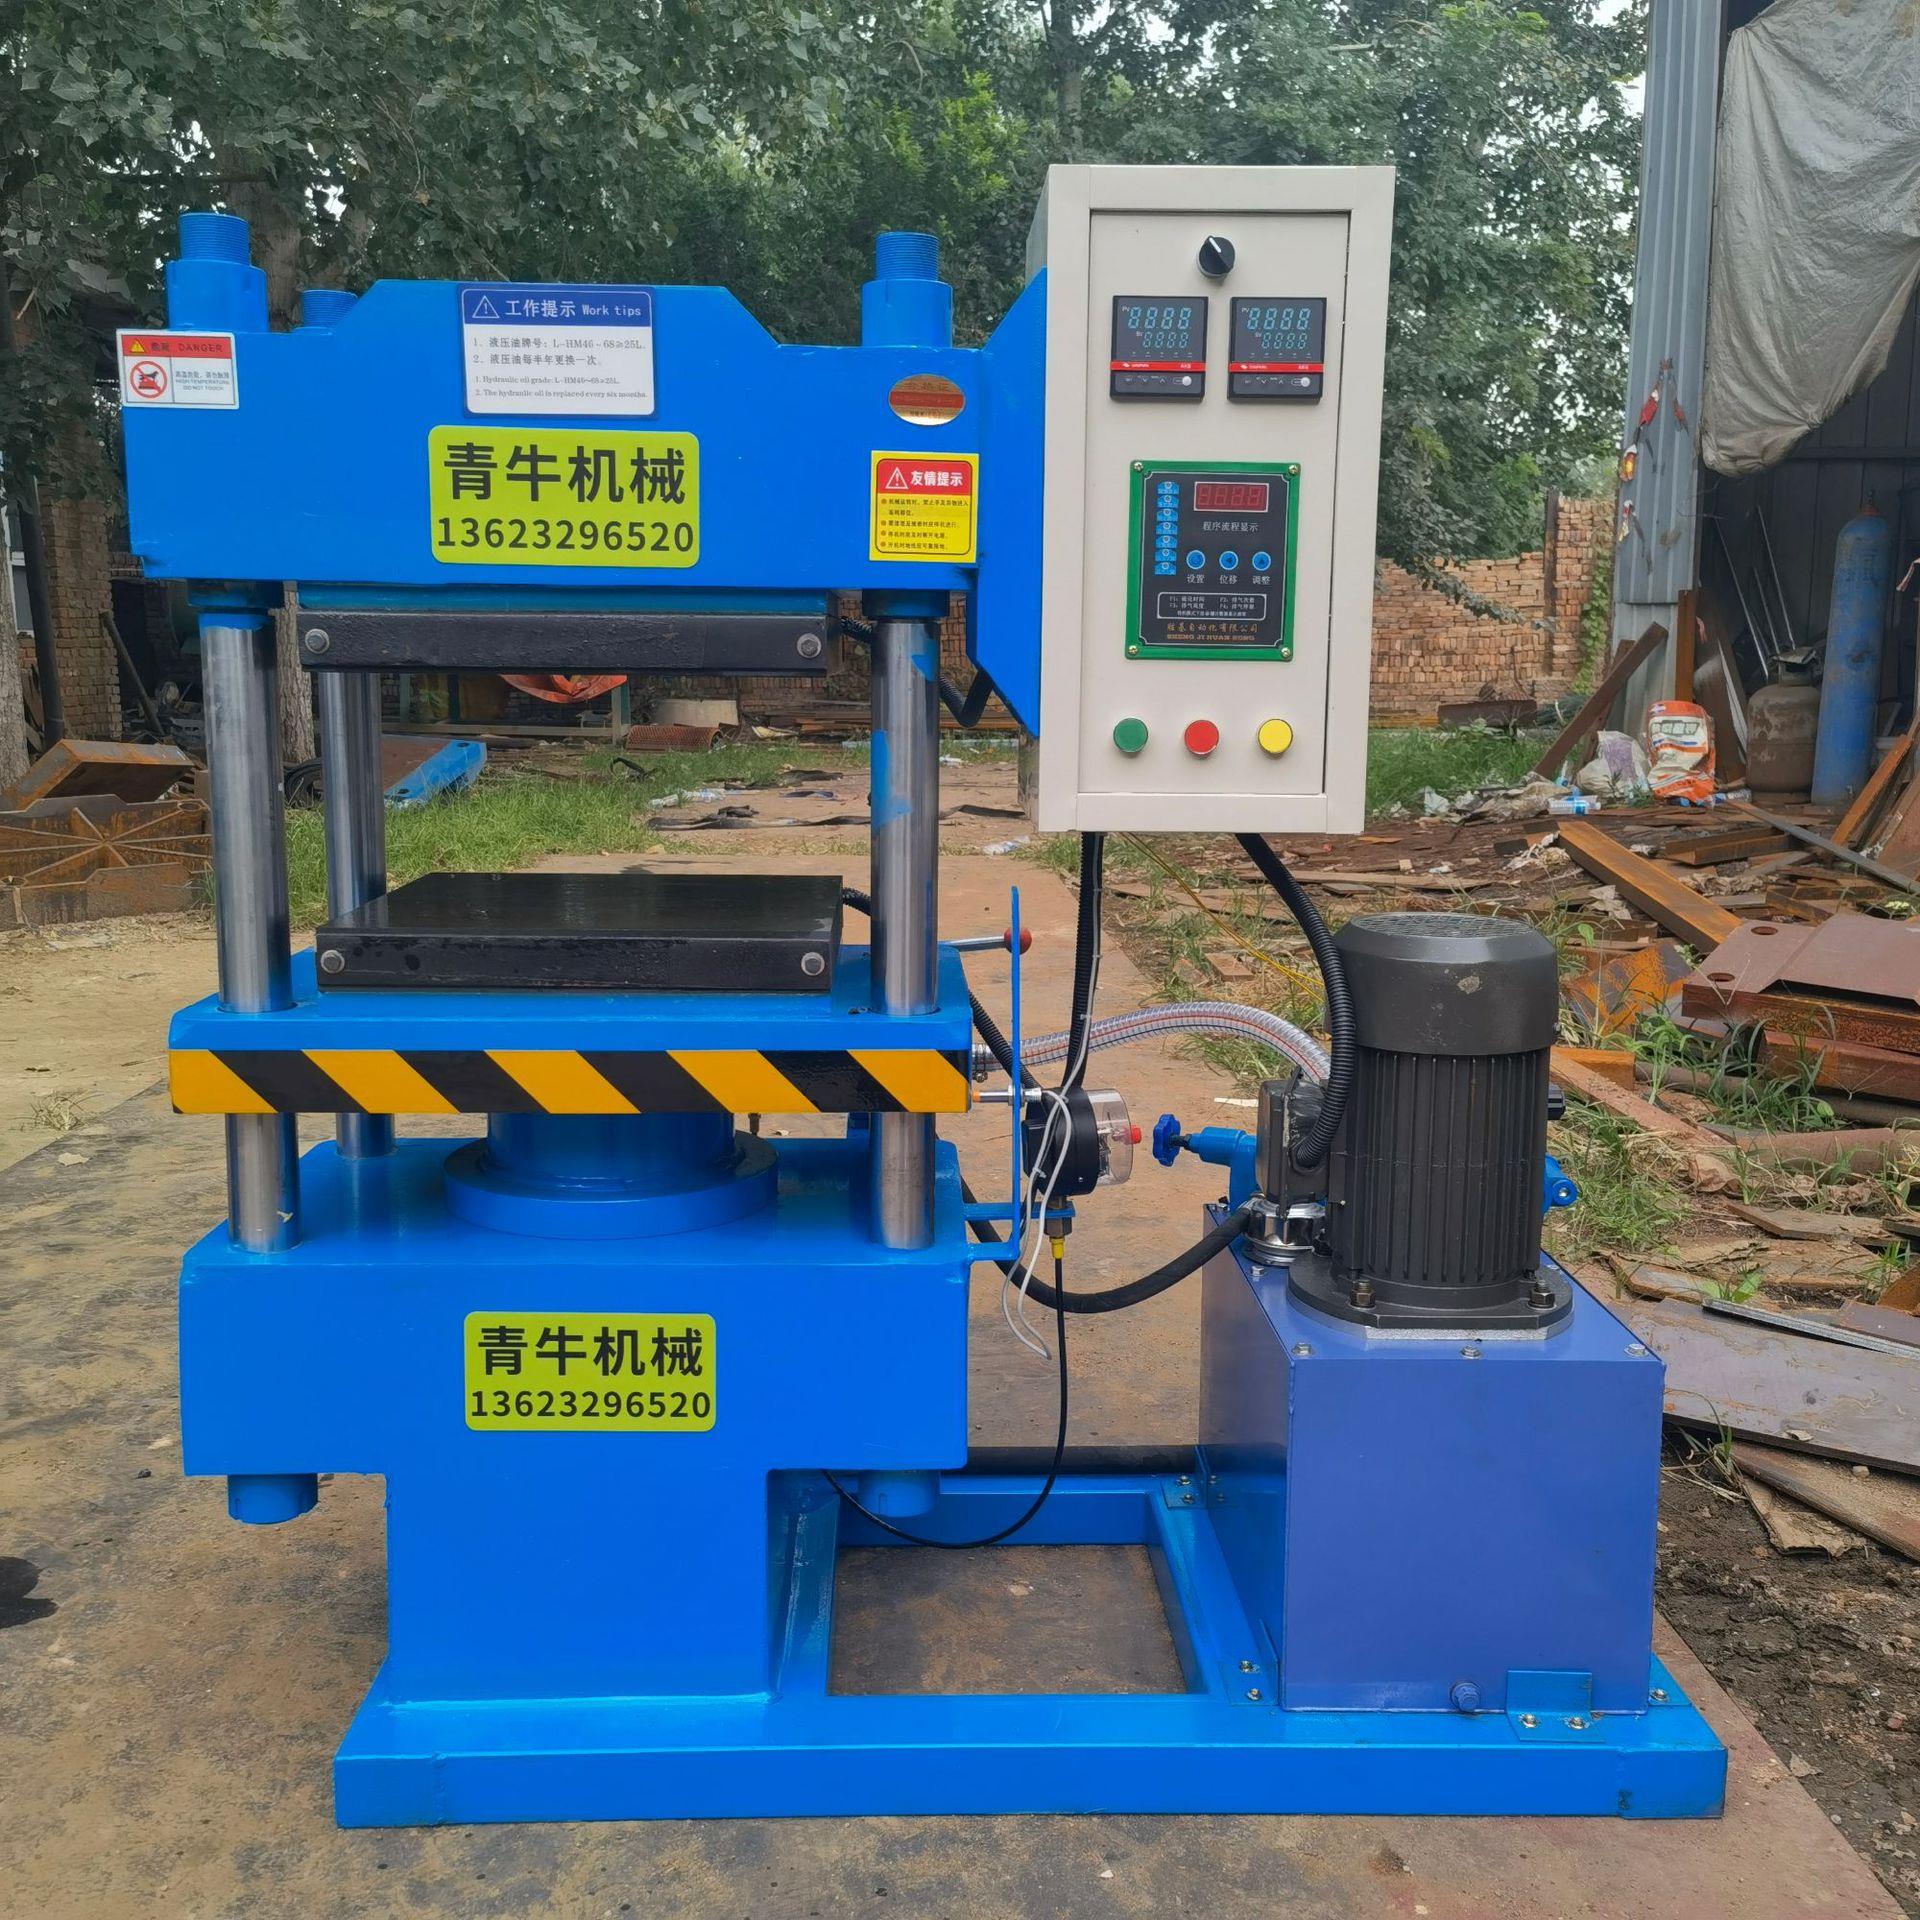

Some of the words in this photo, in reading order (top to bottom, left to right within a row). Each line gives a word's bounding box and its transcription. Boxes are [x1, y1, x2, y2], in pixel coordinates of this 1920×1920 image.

[505, 299, 576, 318] 工作提示
[581, 303, 609, 316] Work
[615, 305, 642, 318] tips
[178, 342, 223, 352] DANGER
[482, 375, 518, 385] Hydraulic
[484, 389, 497, 397] The
[498, 389, 533, 399] hydraulic
[552, 390, 584, 399] replaced
[585, 391, 605, 400] every
[444, 442, 686, 504] 青牛机械
[910, 471, 964, 487] 友情提示
[1202, 521, 1259, 532] 程序流程显示
[438, 517, 694, 552] 13623296520
[1186, 574, 1206, 584] 设置
[1219, 574, 1238, 585] 位移
[1252, 575, 1271, 586] 调整
[478, 1325, 703, 1377] 青牛机械
[471, 1390, 711, 1418] 13623296520
